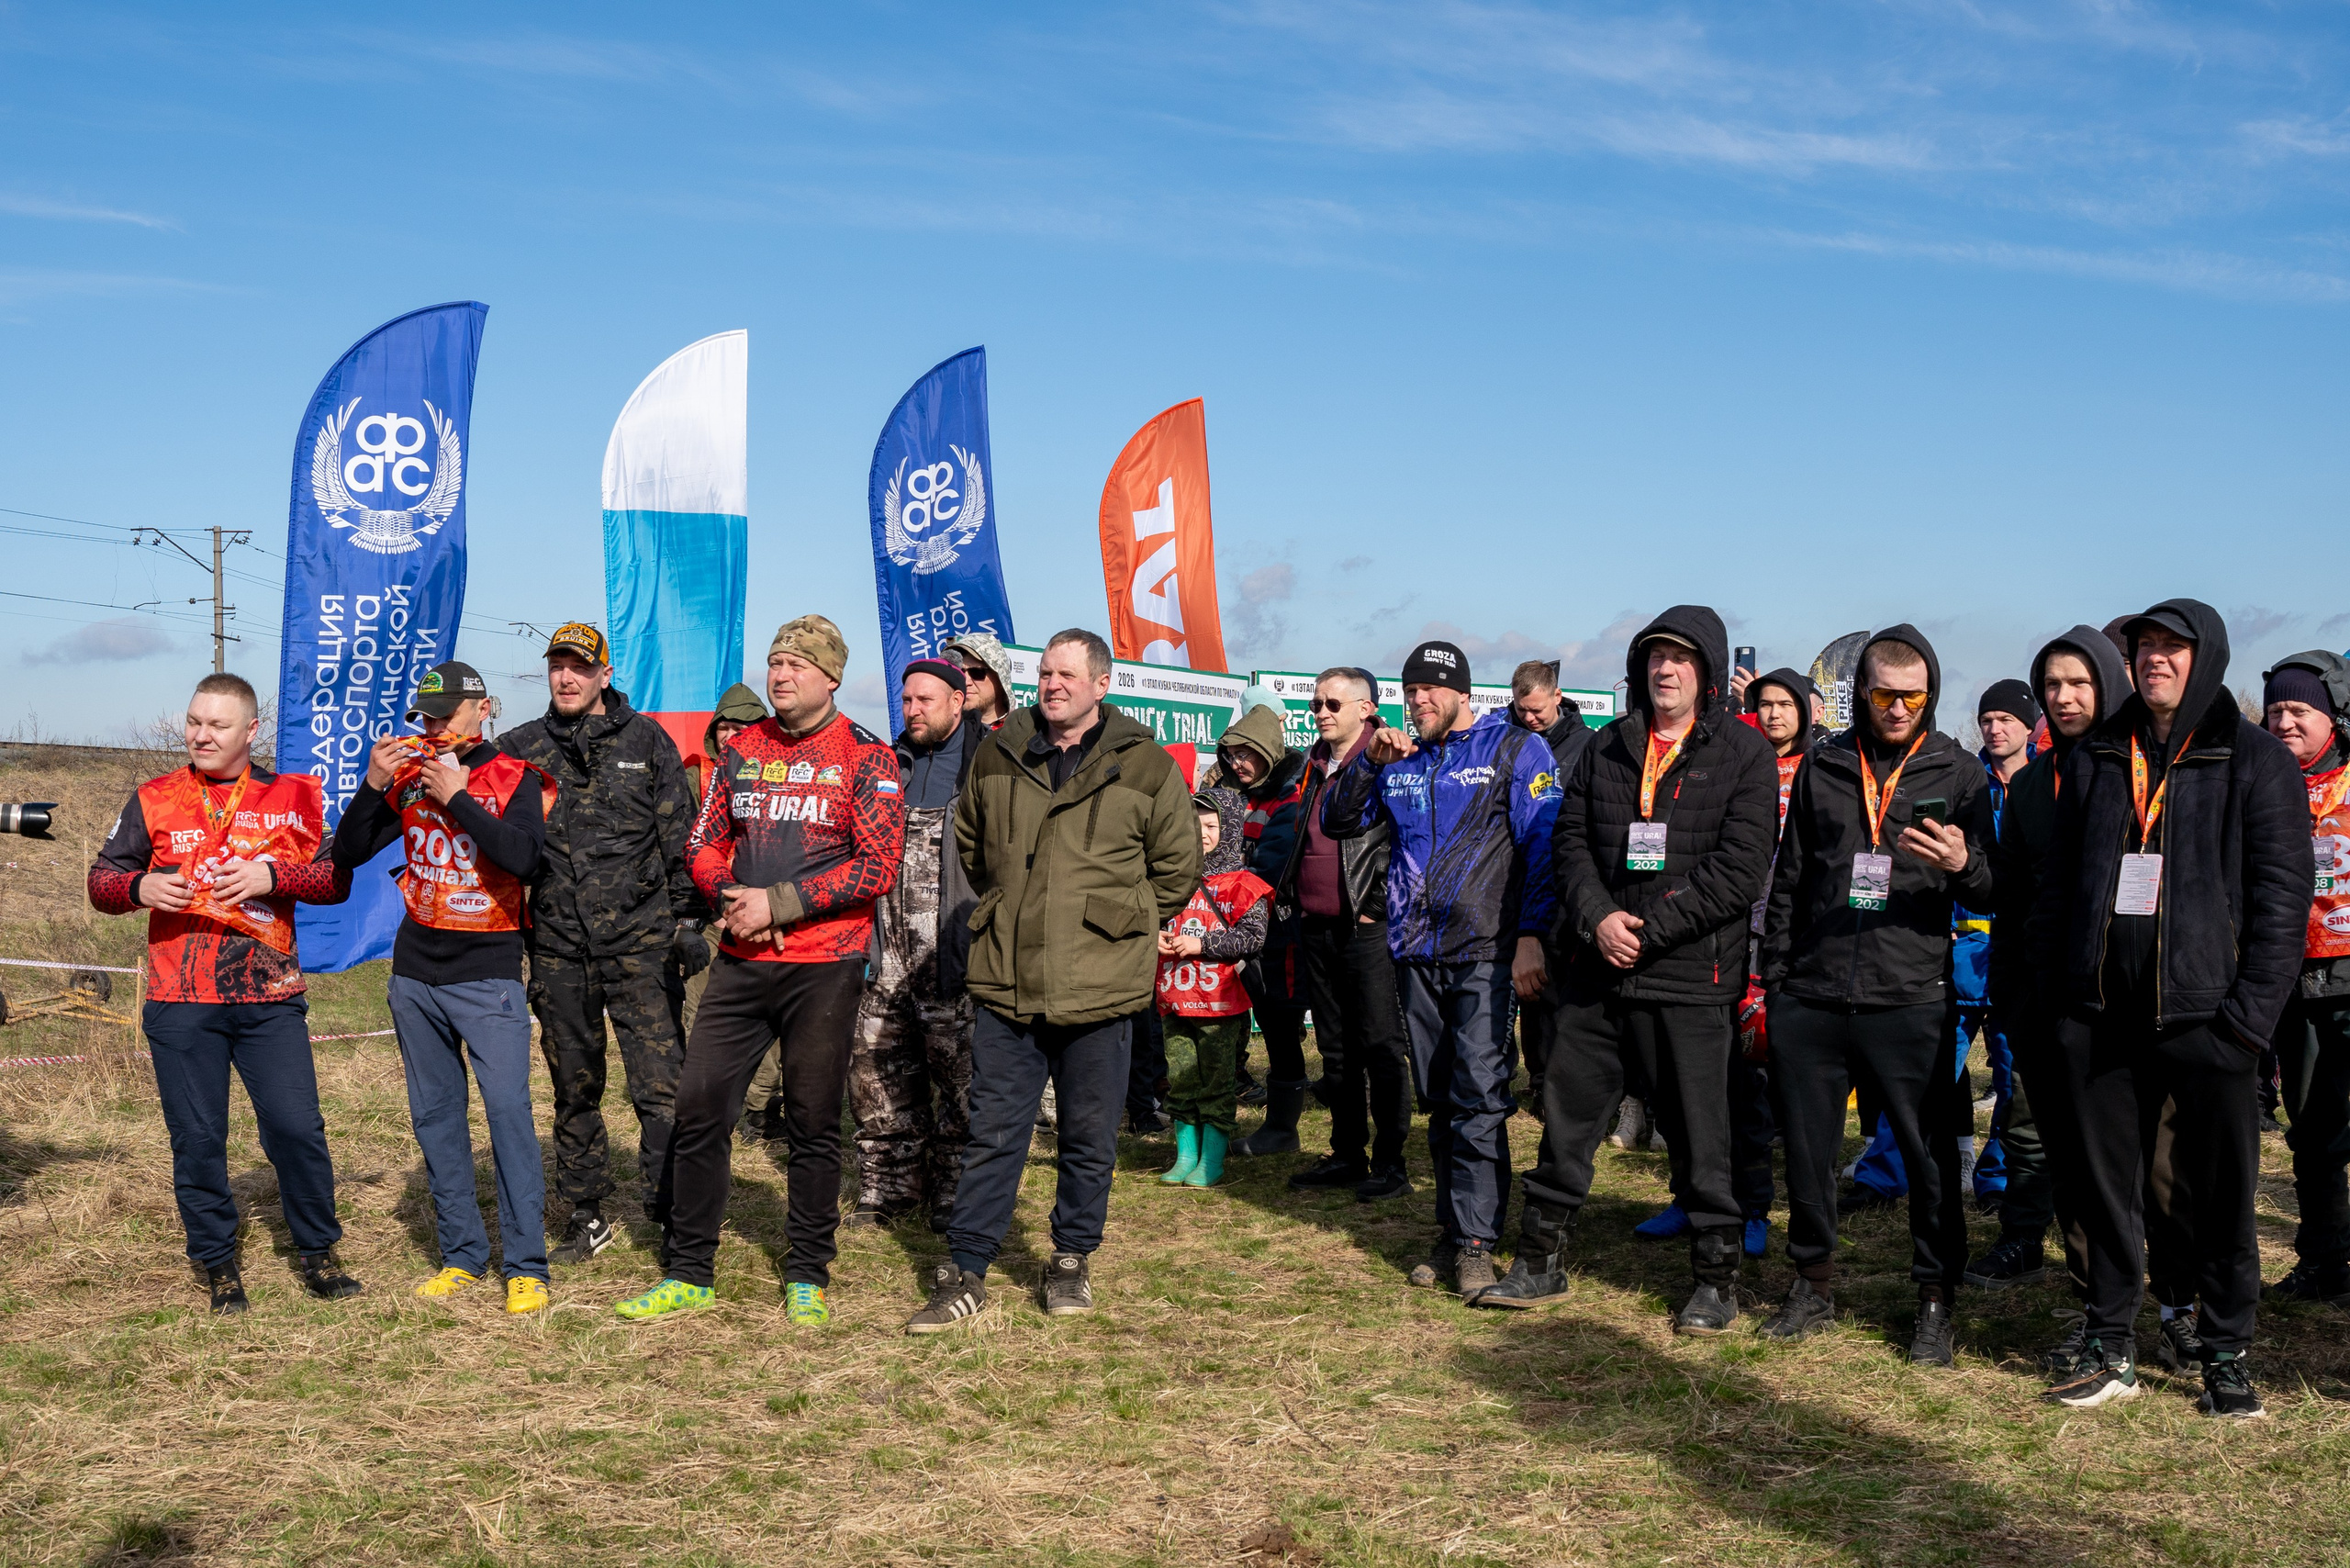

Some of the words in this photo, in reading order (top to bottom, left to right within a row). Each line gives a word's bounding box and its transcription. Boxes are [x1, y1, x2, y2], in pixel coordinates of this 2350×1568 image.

[560, 636, 588, 645] BRUINS
[1424, 649, 1457, 663] GROZA
[1444, 660, 1457, 668] TEAM
[1117, 672, 1136, 688] 2026
[1147, 679, 1158, 690] ЭТАП
[1158, 680, 1172, 691] КУБКА
[1171, 682, 1200, 695] ЧЕЛЯБИНСКОЙ
[1200, 685, 1217, 698] ОБЛАСТИ
[1485, 695, 1504, 704] КУБКА
[1822, 681, 1839, 722] STEEL
[1838, 684, 1849, 720] PIKE
[1172, 711, 1216, 745] TRIAL
[768, 794, 831, 825] URAL
[1643, 832, 1663, 840] URAL
[408, 826, 477, 870] 209
[1633, 860, 1658, 870] 202
[1867, 866, 1887, 875] URAL
[449, 897, 487, 907] SINTEC
[1854, 898, 1880, 910] 202
[242, 902, 274, 920] SINTEC
[1160, 959, 1220, 992] 305
